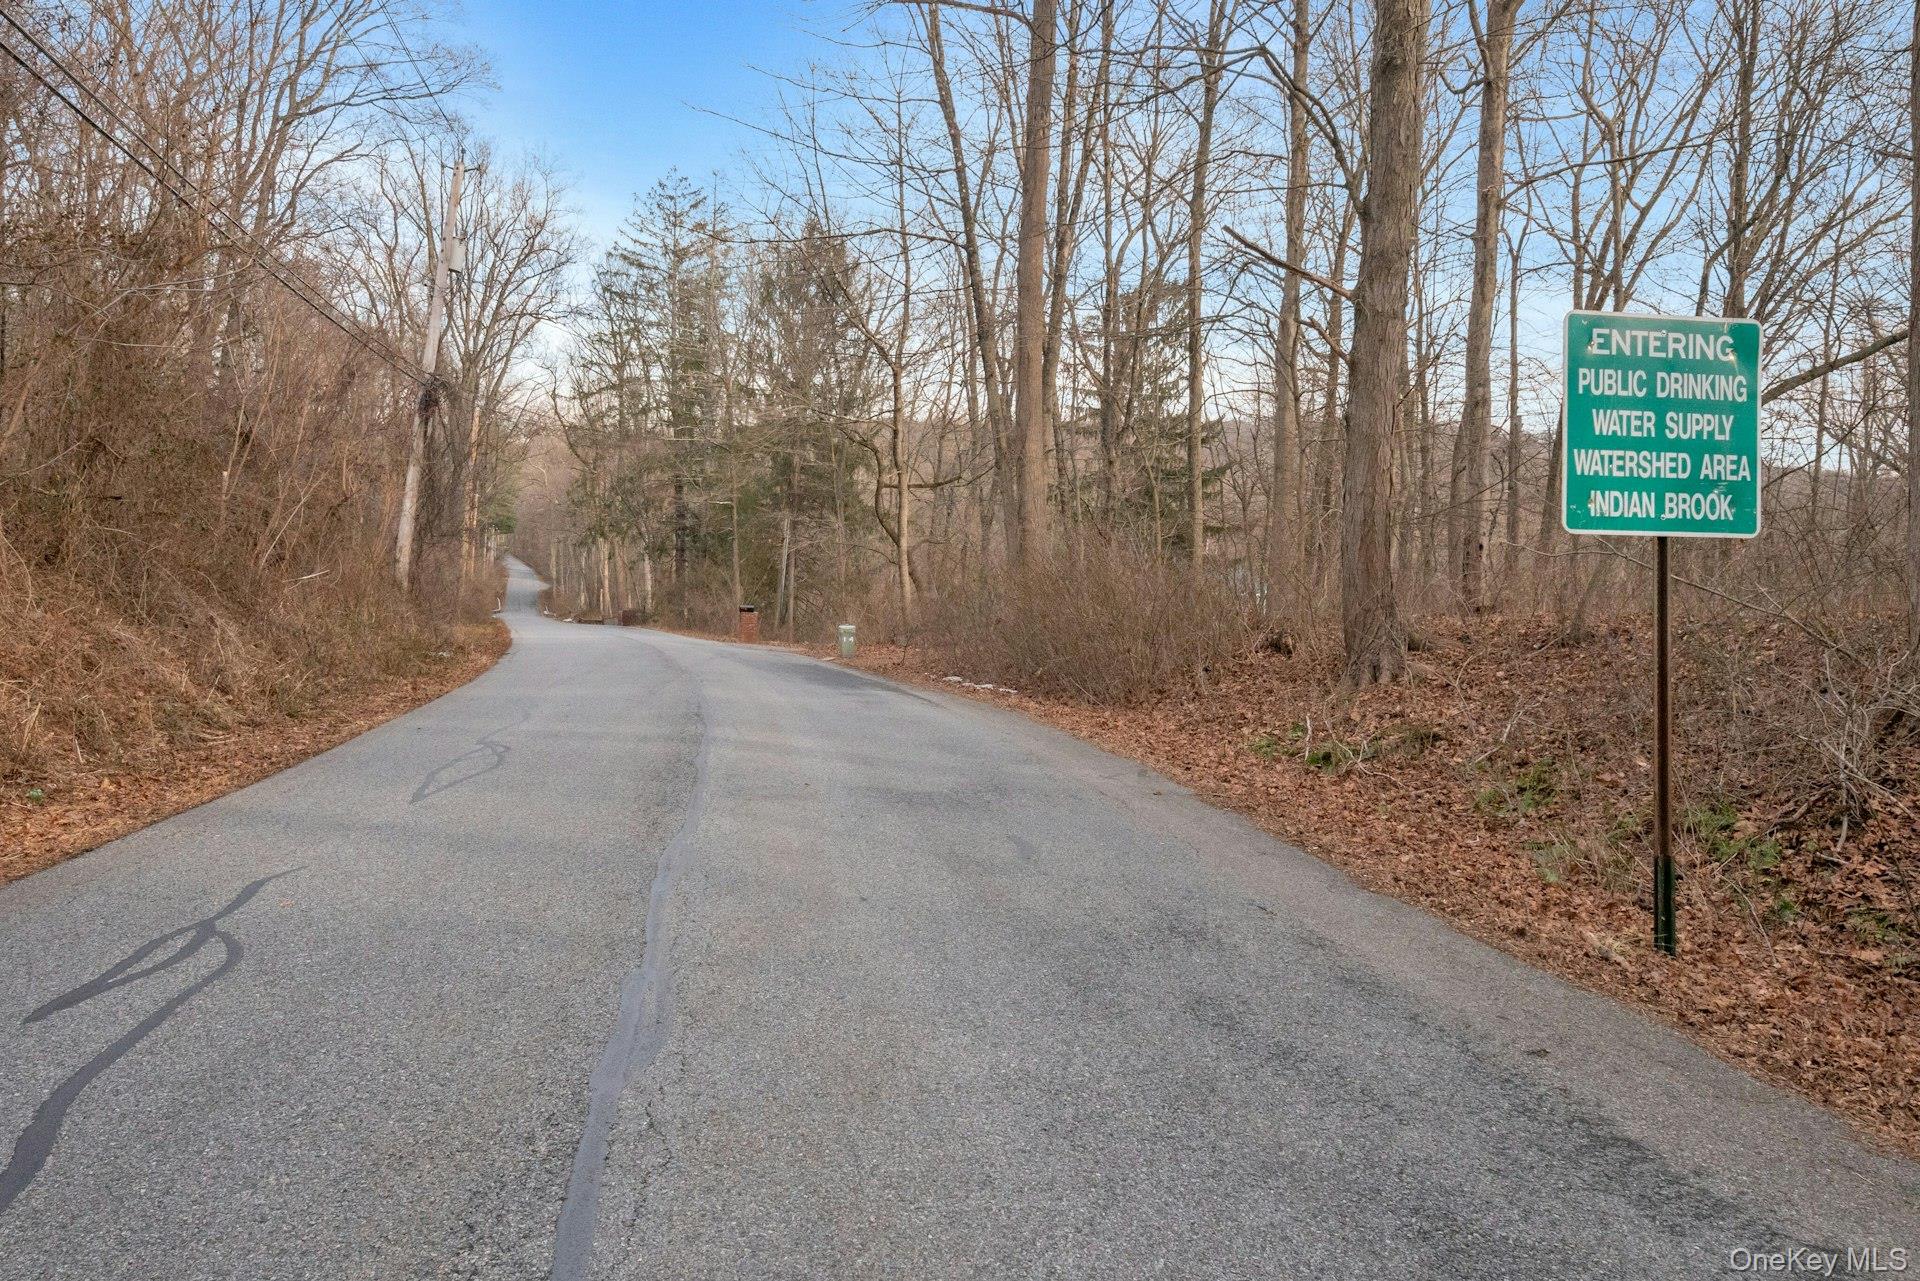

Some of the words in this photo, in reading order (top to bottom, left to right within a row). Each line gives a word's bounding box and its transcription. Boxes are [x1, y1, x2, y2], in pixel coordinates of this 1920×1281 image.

[1592, 328, 1734, 361] ENTERING
[1578, 368, 1647, 397] PUBLIC
[1656, 372, 1747, 402] DRINKING
[1592, 409, 1656, 437] WATER
[1665, 412, 1734, 440] SUPPLY
[1573, 449, 1691, 479] WATERSHED
[1700, 454, 1751, 481] AREA
[1590, 490, 1655, 518] INDIAN
[1664, 492, 1733, 520] BROOK
